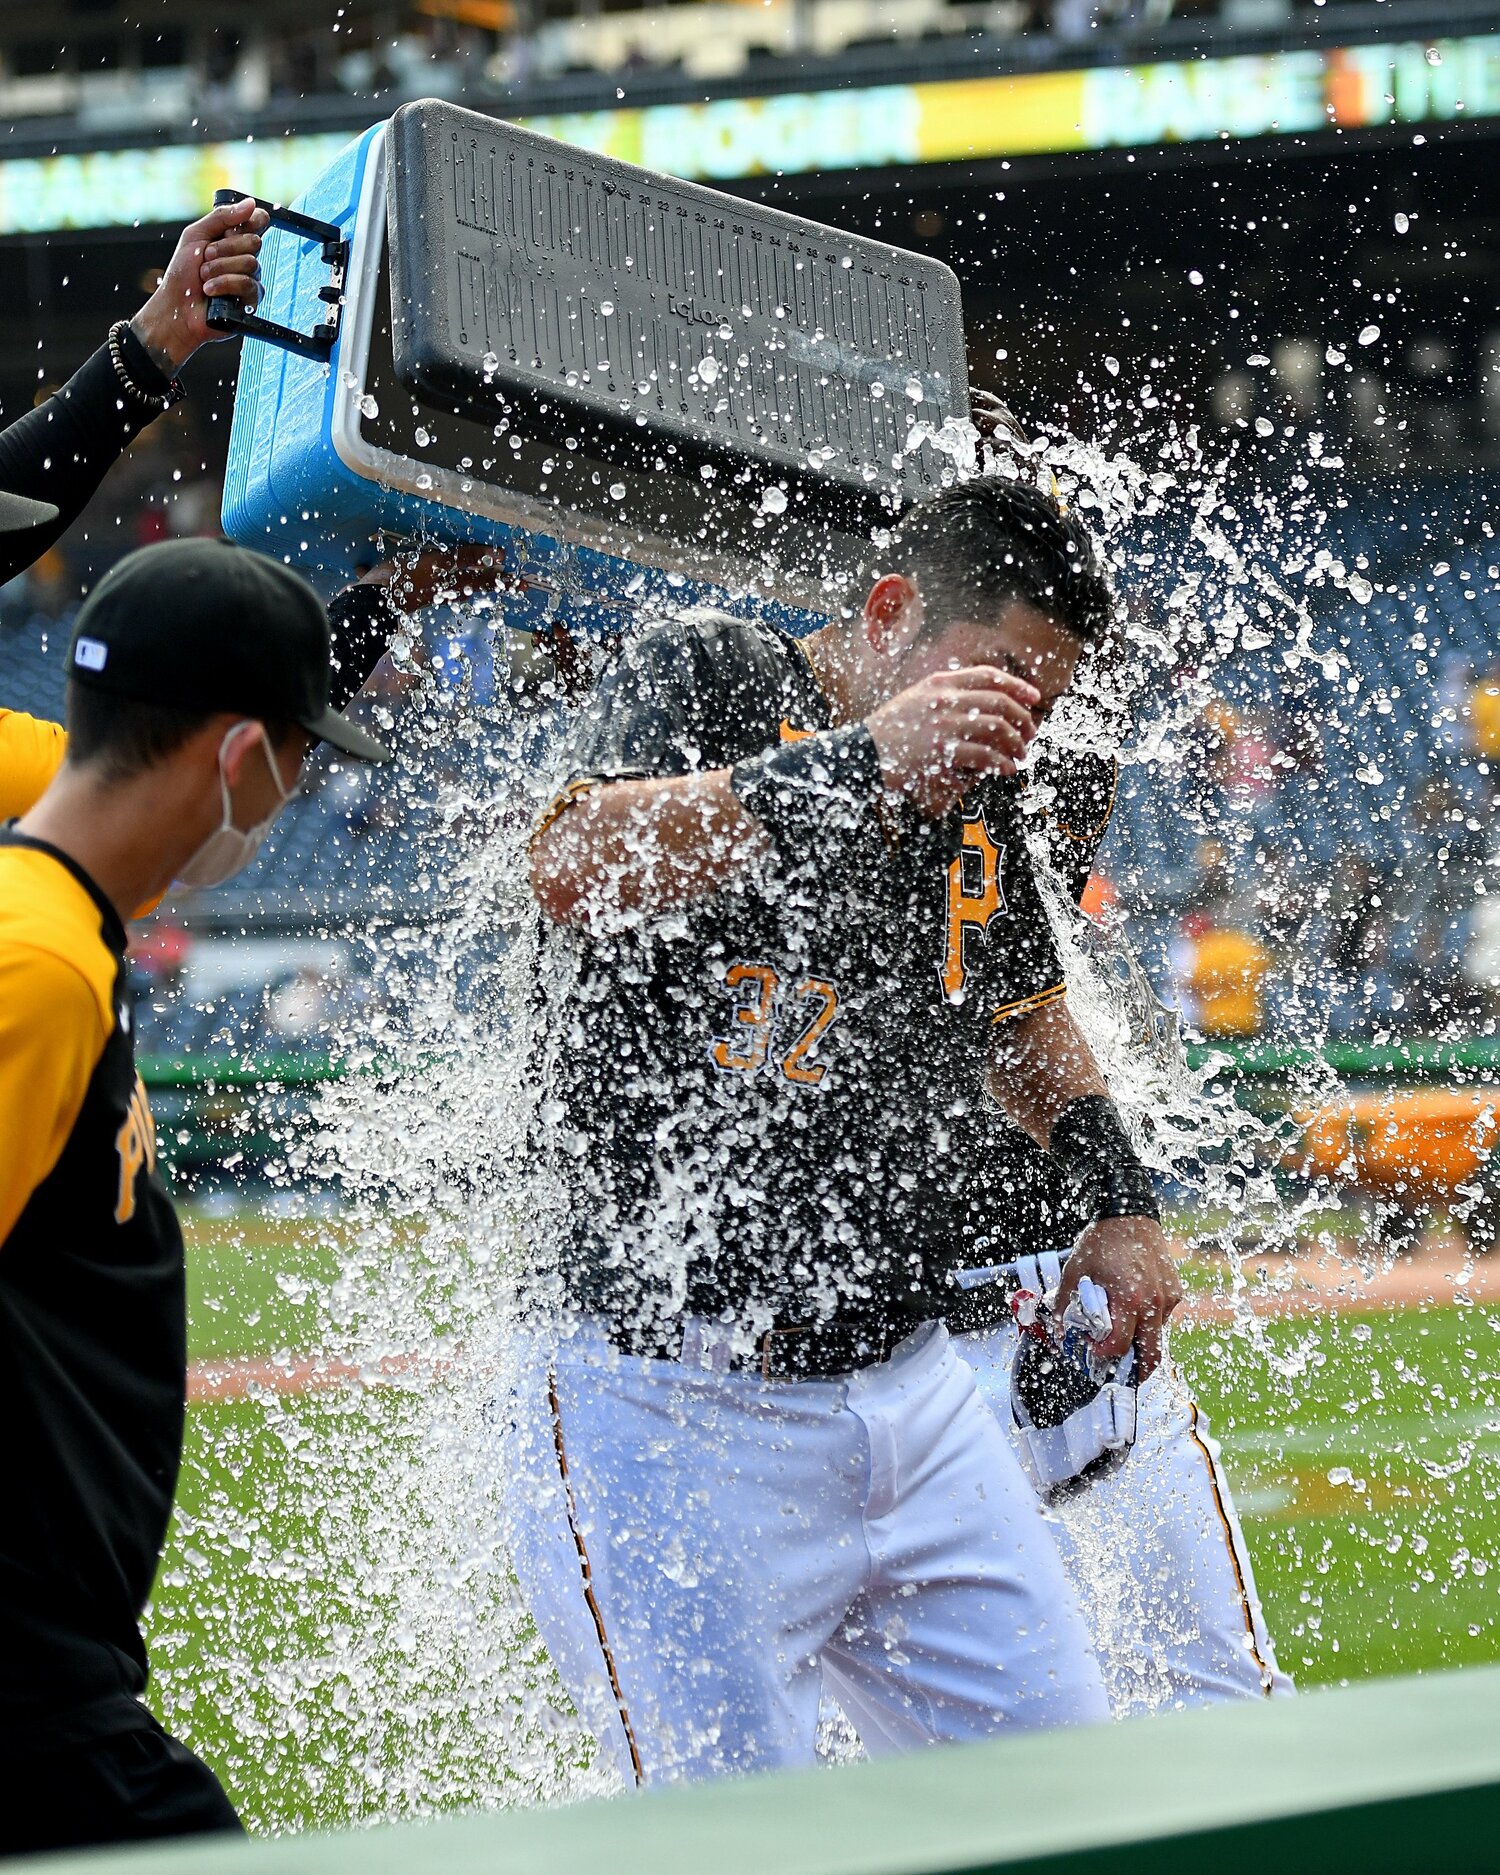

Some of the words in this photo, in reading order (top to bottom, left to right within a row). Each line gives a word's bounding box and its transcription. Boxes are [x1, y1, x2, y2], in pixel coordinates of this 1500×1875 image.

[451, 132, 458, 141] 0
[470, 138, 478, 149] 2
[639, 193, 651, 206] 20
[657, 200, 669, 212] 22
[676, 207, 688, 218] 24
[695, 212, 707, 224] 26
[825, 253, 836, 264] 40
[460, 332, 468, 344] 0
[509, 349, 517, 361] 2
[702, 409, 716, 423] 10
[727, 416, 739, 430] 11
[774, 429, 788, 444] 13
[937, 804, 1008, 1004] P
[706, 957, 841, 1089] 32
